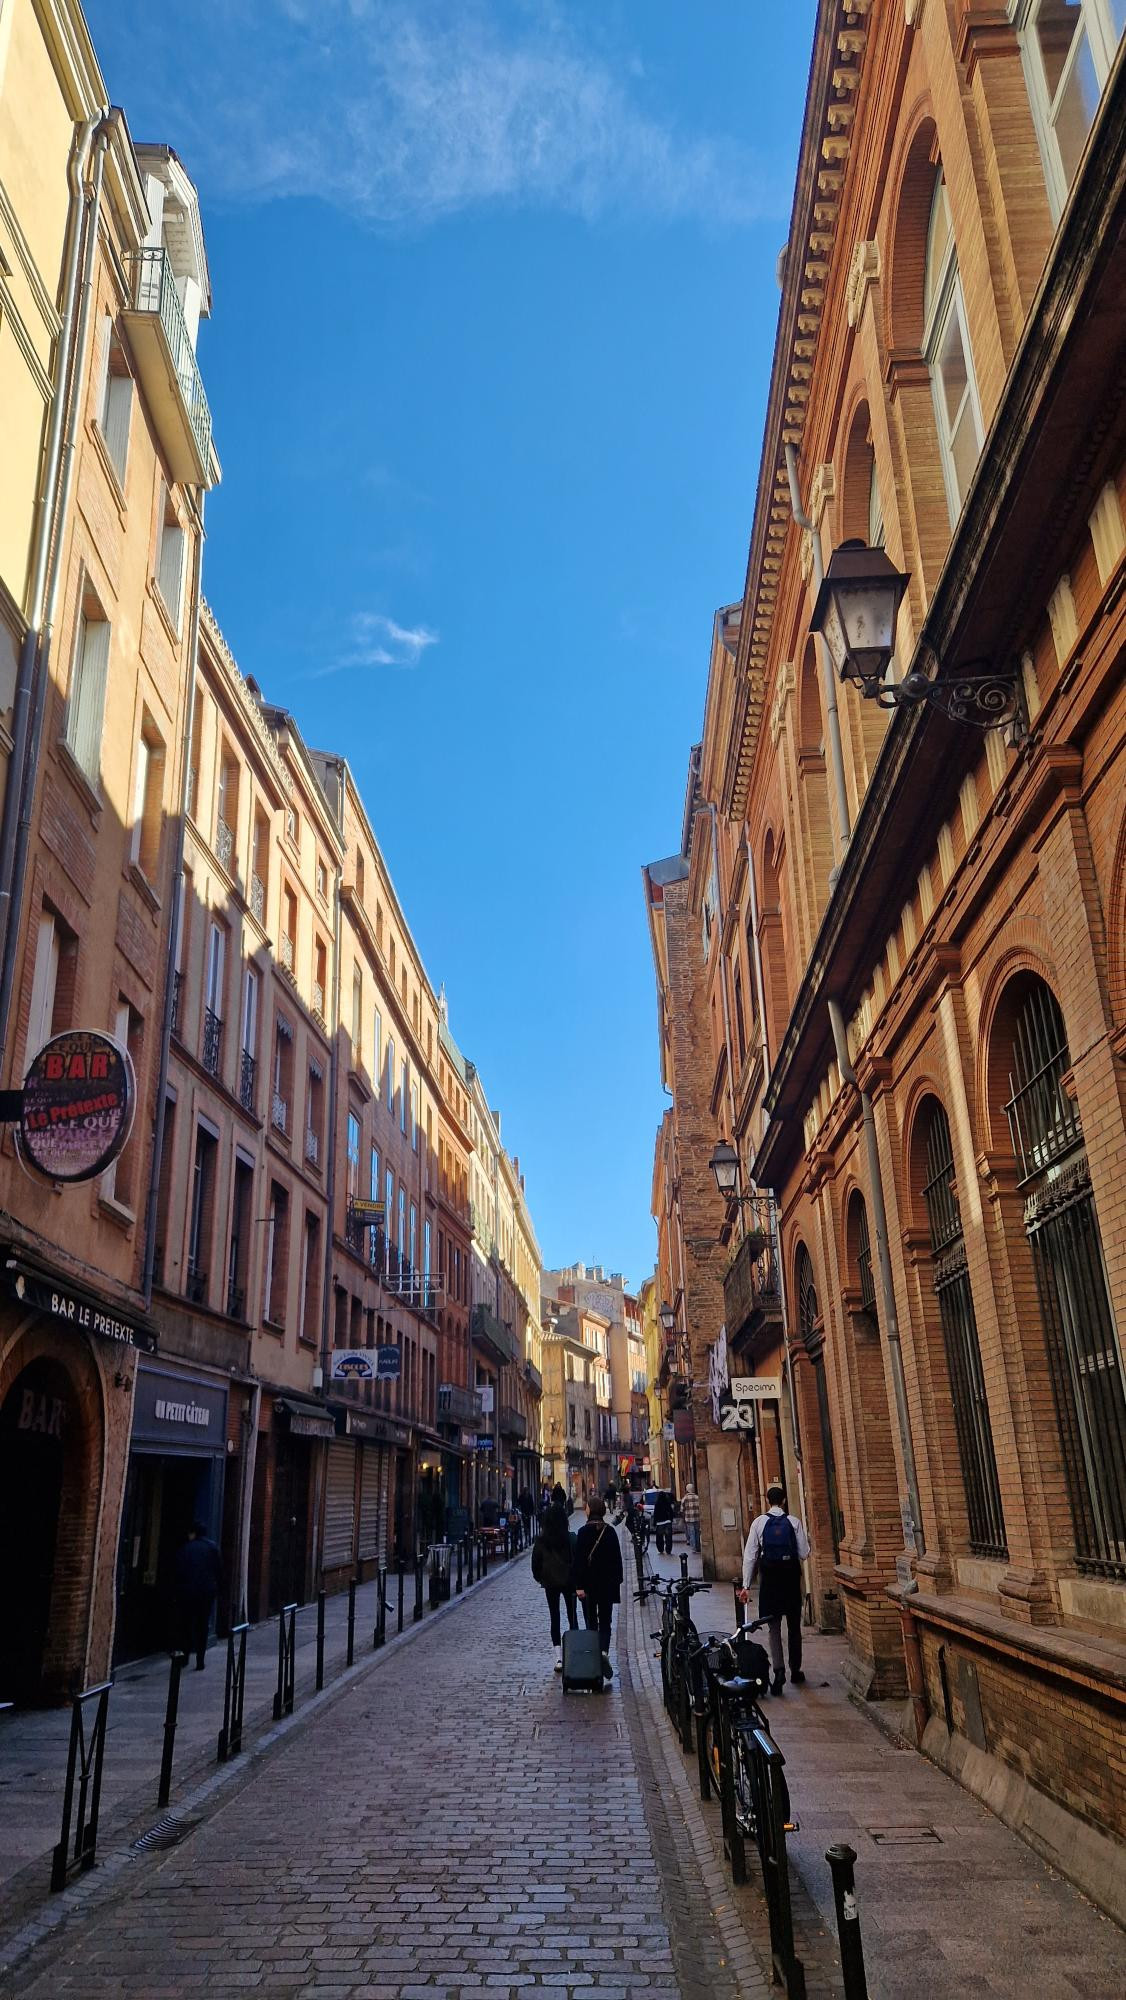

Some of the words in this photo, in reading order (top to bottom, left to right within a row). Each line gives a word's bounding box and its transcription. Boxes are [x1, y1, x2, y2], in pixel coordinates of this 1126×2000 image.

[45, 1053, 109, 1080] BAR
[28, 1111, 48, 1130] Le
[49, 1091, 118, 1122] Prétexte
[83, 1116, 120, 1129] QUE
[51, 1293, 75, 1320] BAR
[79, 1305, 90, 1327] LE
[93, 1312, 134, 1345] PRÉTEXTE
[735, 1382, 776, 1394] Specimn
[155, 1399, 166, 1419] UN
[165, 1401, 186, 1422] PETIT
[185, 1400, 210, 1426] GÂTEAU
[720, 1404, 754, 1431] 23
